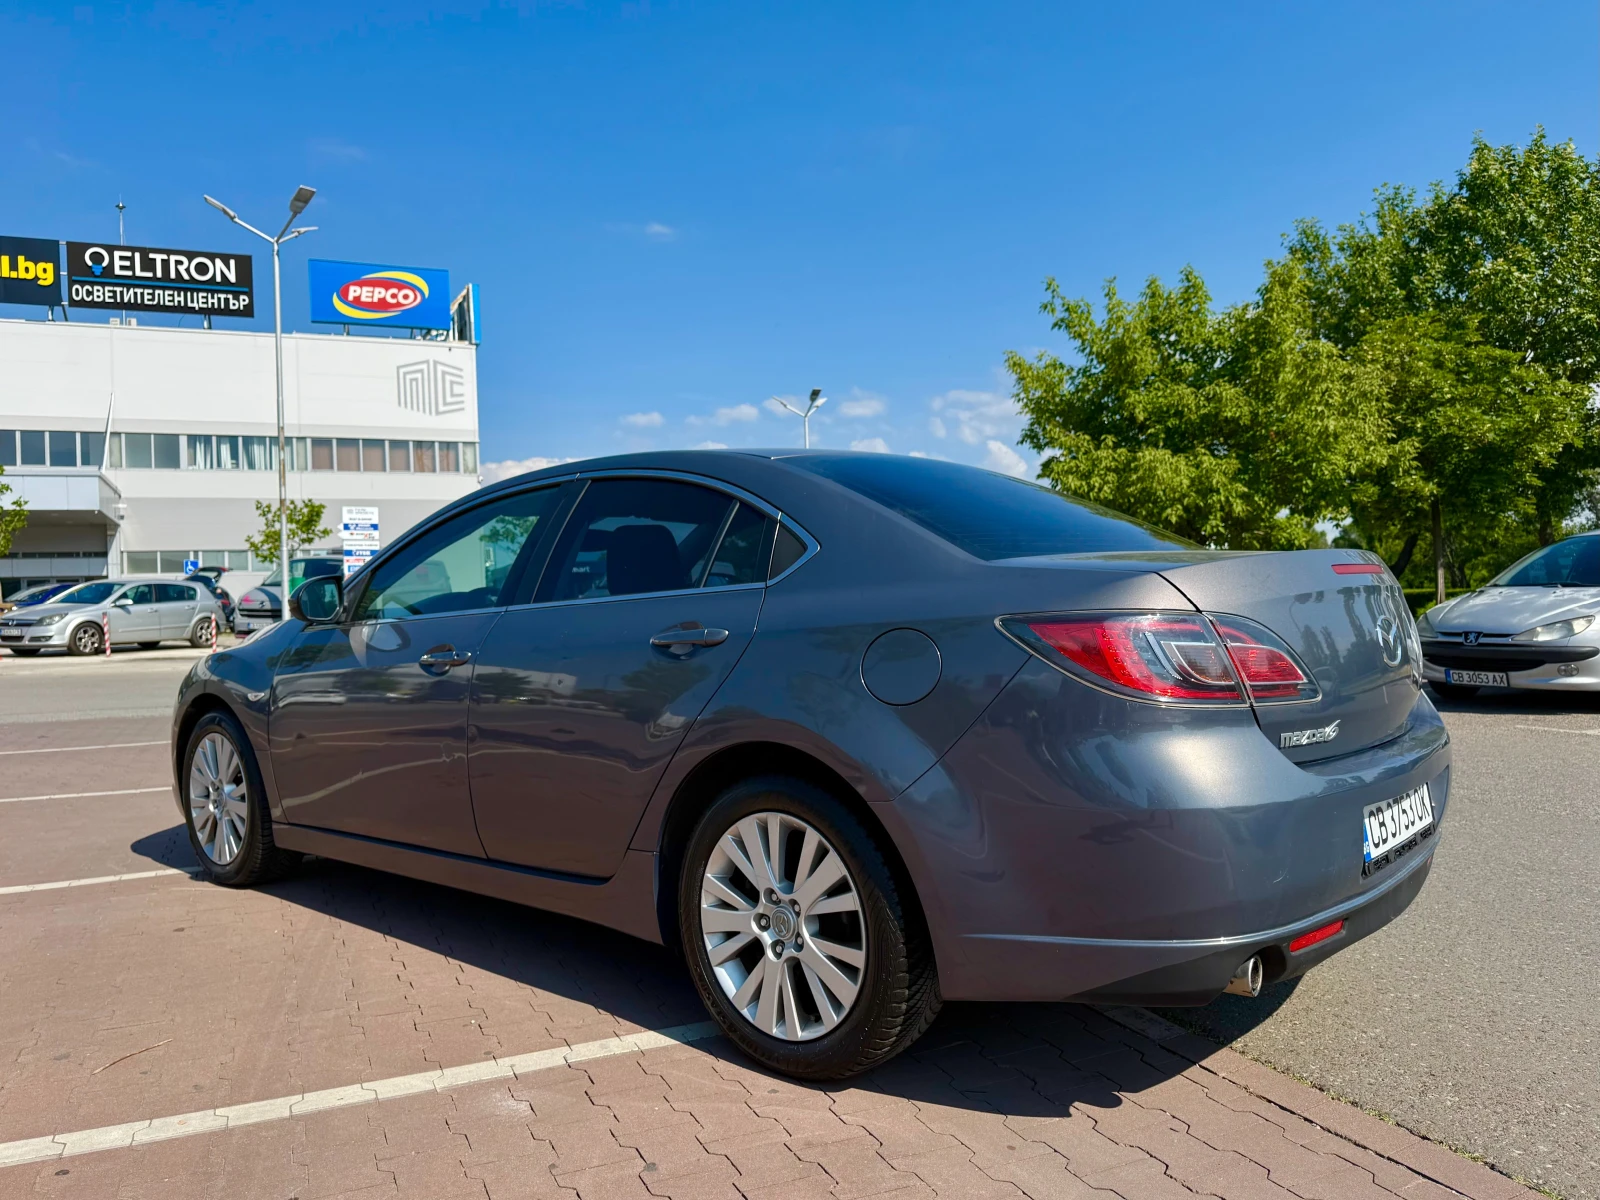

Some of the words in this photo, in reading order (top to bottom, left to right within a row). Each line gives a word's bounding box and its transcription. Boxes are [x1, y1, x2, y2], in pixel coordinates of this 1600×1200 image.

[0, 255, 54, 286] l.bg
[113, 251, 236, 284] ELTRON
[72, 284, 185, 307] ОСВЕТИТЕЛЕН
[187, 293, 249, 311] ЦЕНТЪР
[347, 285, 415, 305] PEPCO
[1465, 672, 1489, 684] 3053
[1368, 805, 1389, 849] CB
[1386, 792, 1416, 839] 3753
